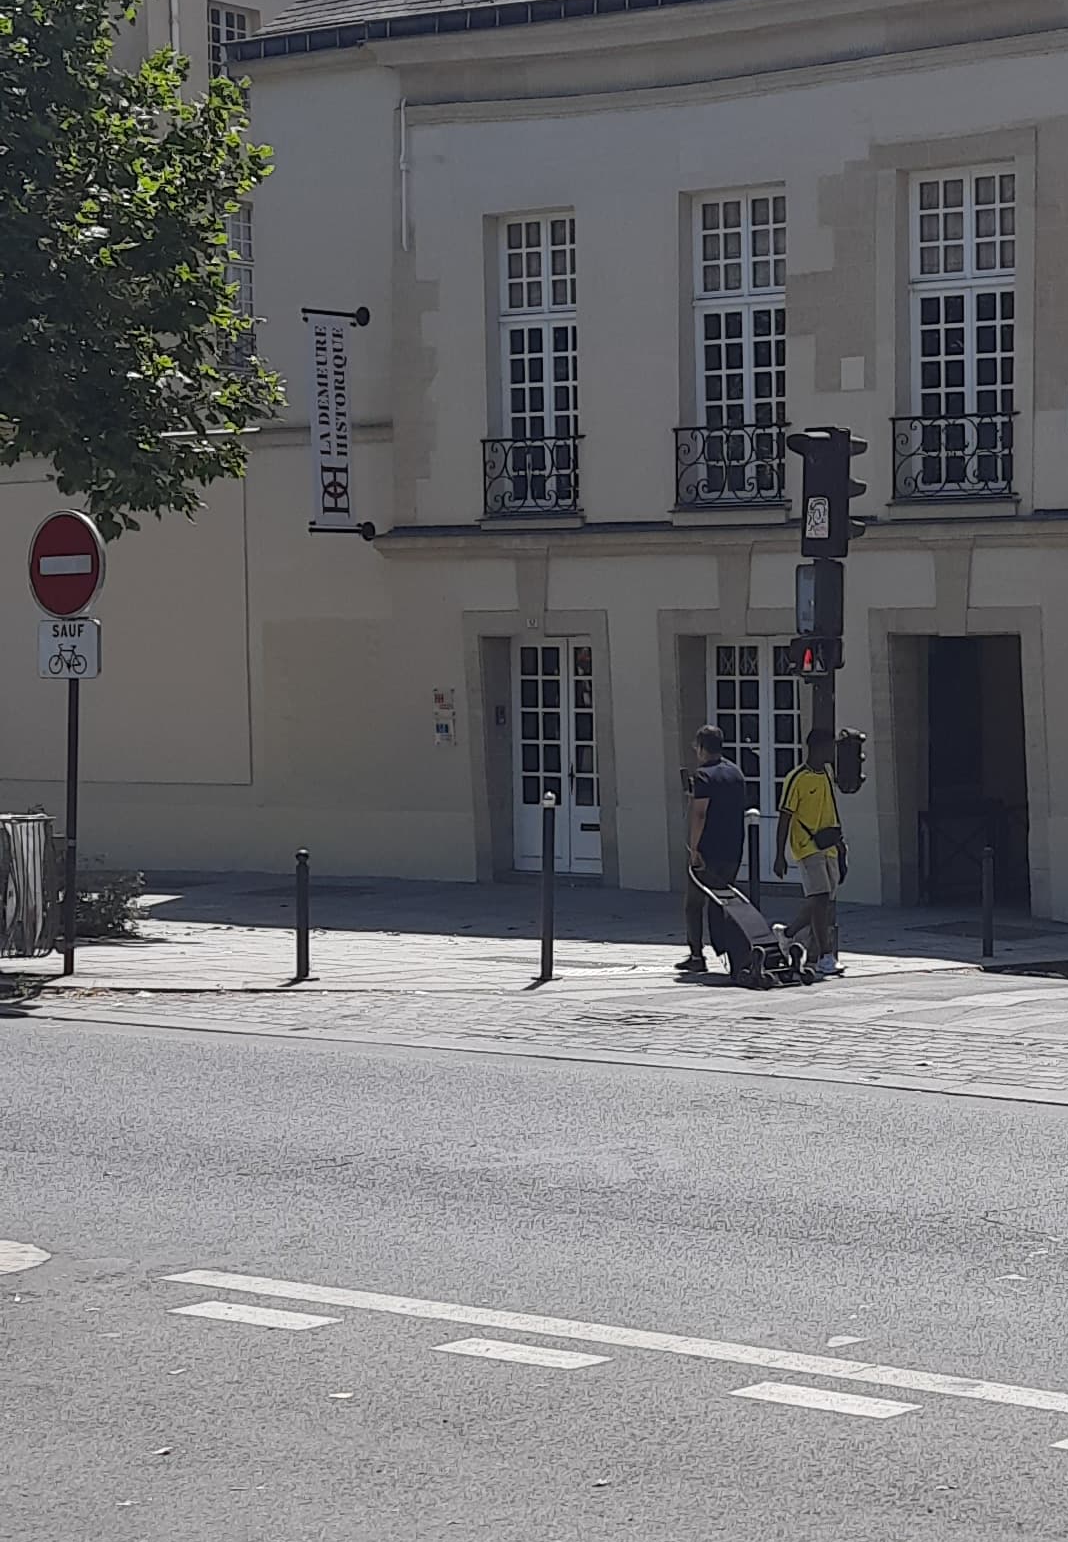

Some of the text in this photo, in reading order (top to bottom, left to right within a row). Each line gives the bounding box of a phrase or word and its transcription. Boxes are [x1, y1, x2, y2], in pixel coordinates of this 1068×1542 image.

[315, 325, 331, 456] LA DEMEURE
[332, 327, 348, 456] HISTORIQUE
[52, 624, 85, 638] SAUF
